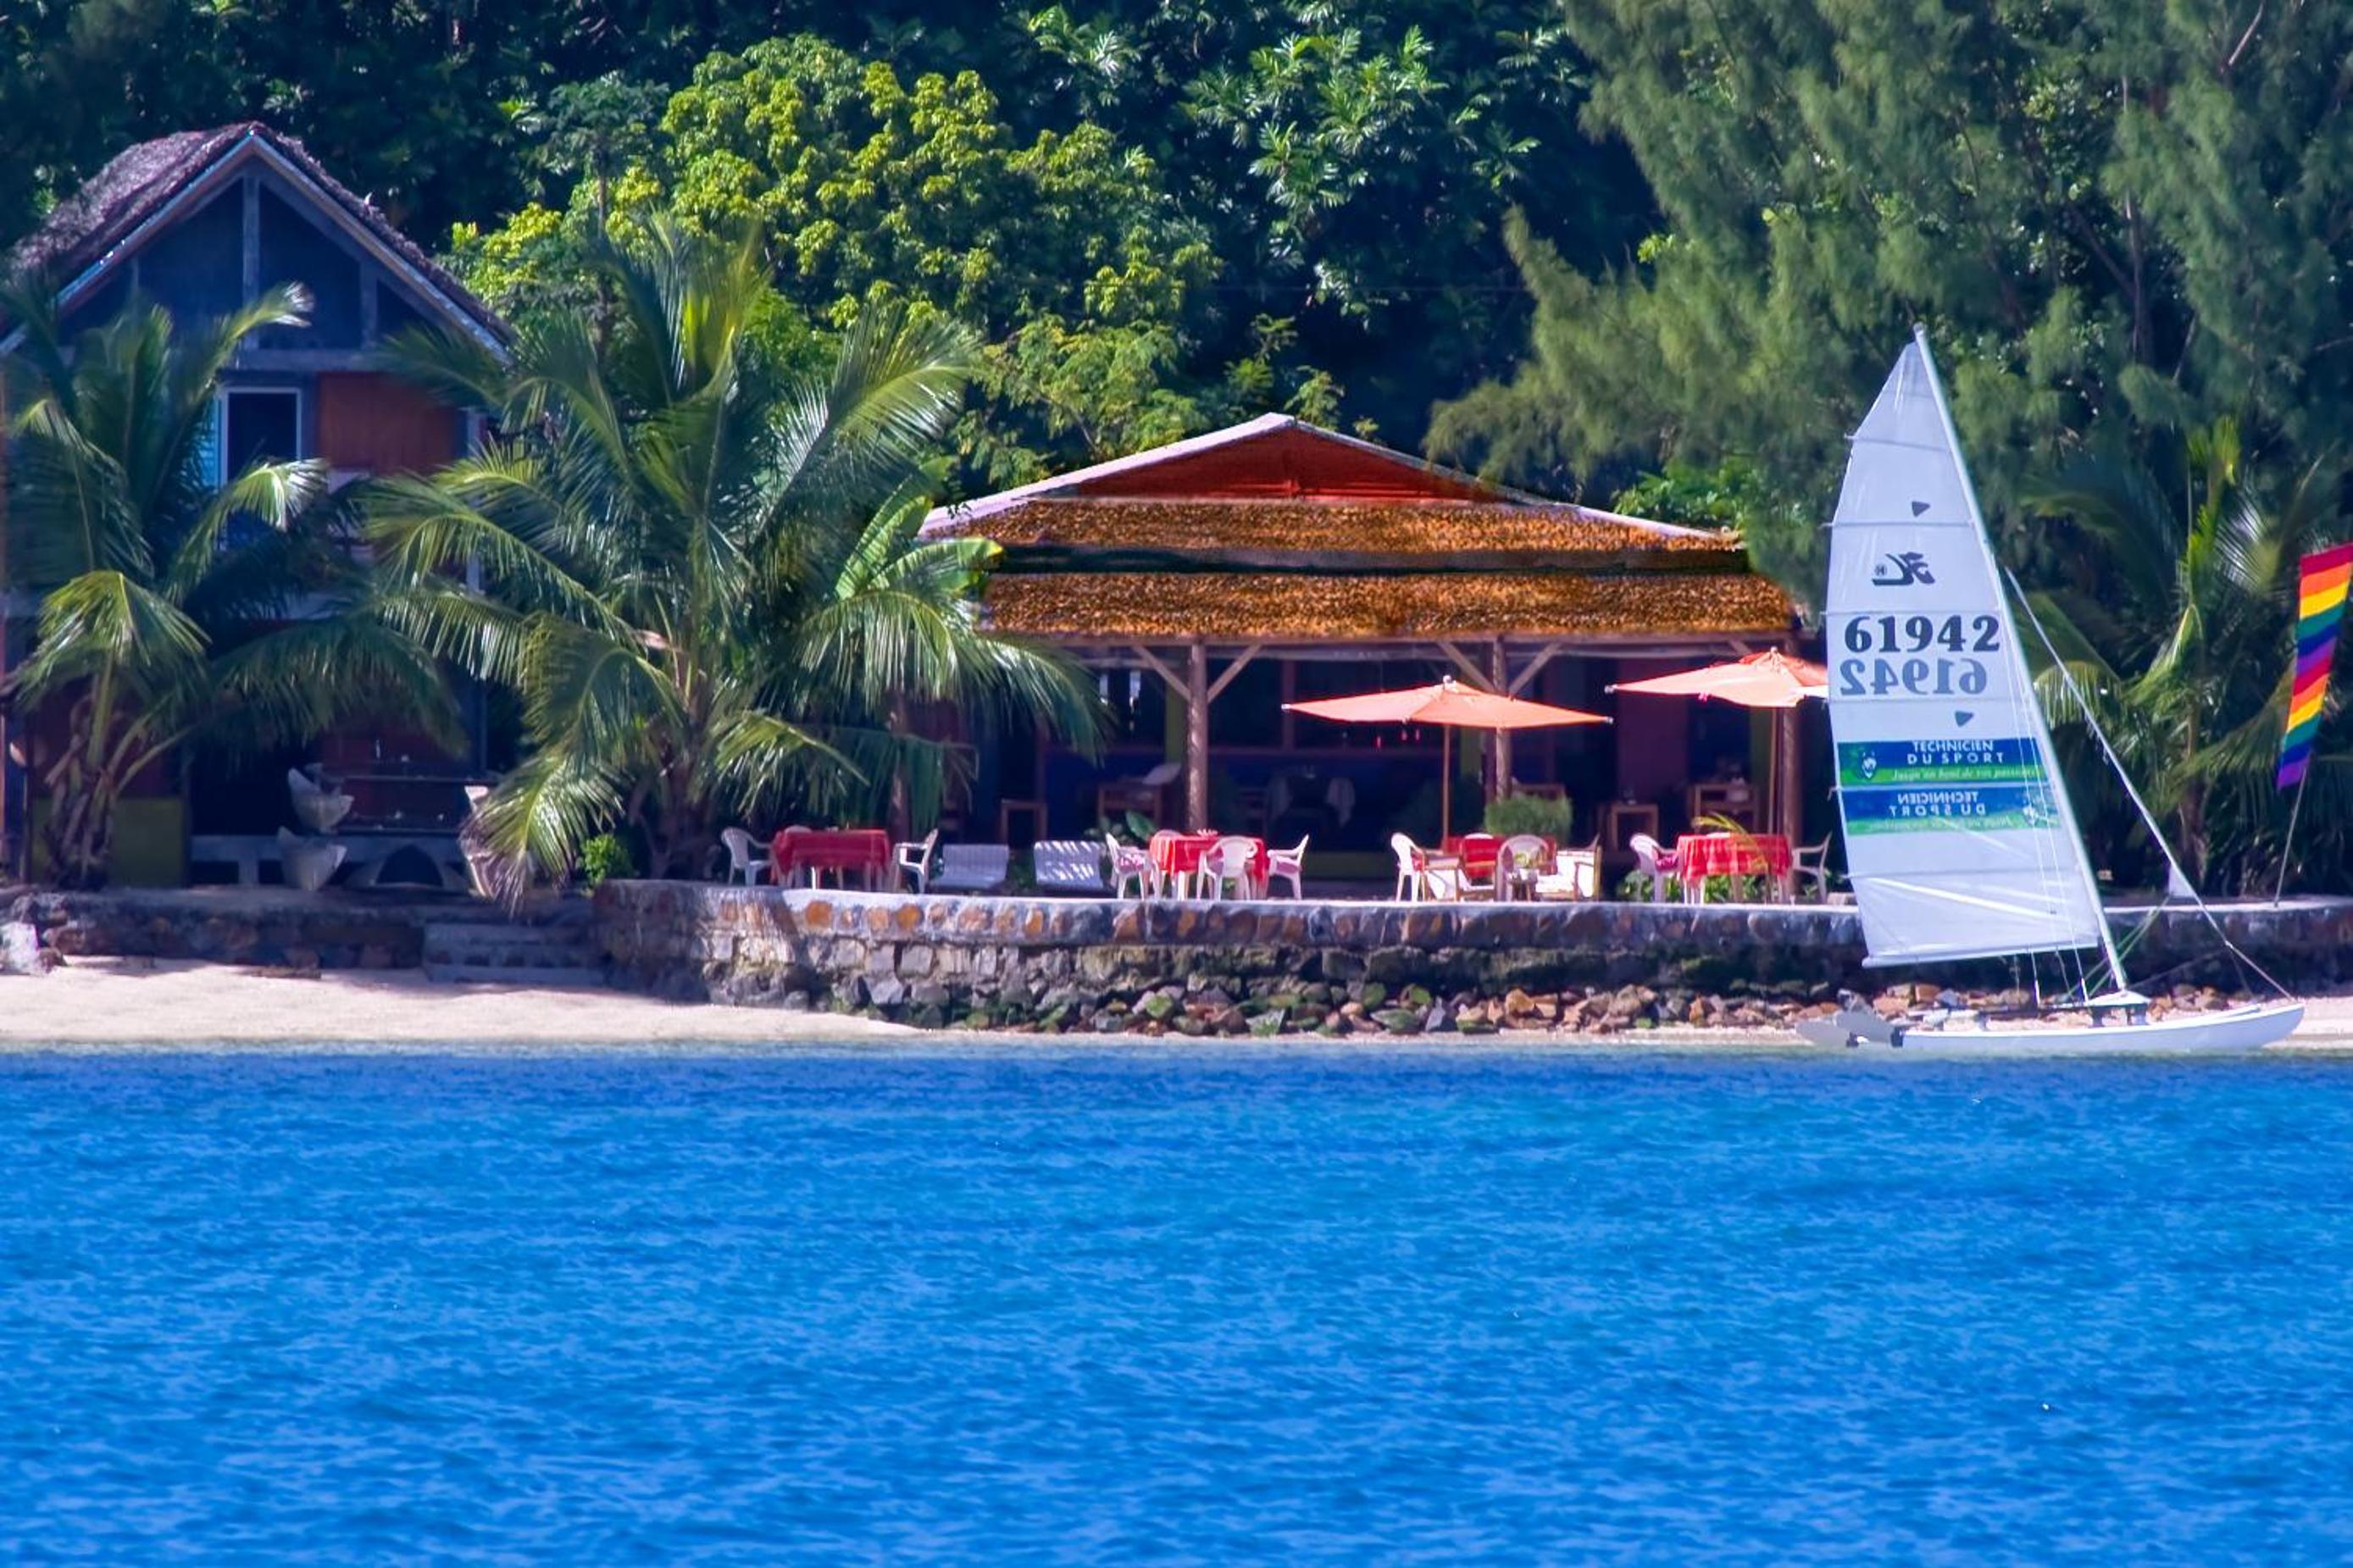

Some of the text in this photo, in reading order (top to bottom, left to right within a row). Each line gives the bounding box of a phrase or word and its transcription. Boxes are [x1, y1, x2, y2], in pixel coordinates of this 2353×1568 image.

[1844, 615, 2000, 653] 61942
[1912, 740, 1995, 752] TECHNICIEN
[1906, 752, 2005, 765] DU SPORT
